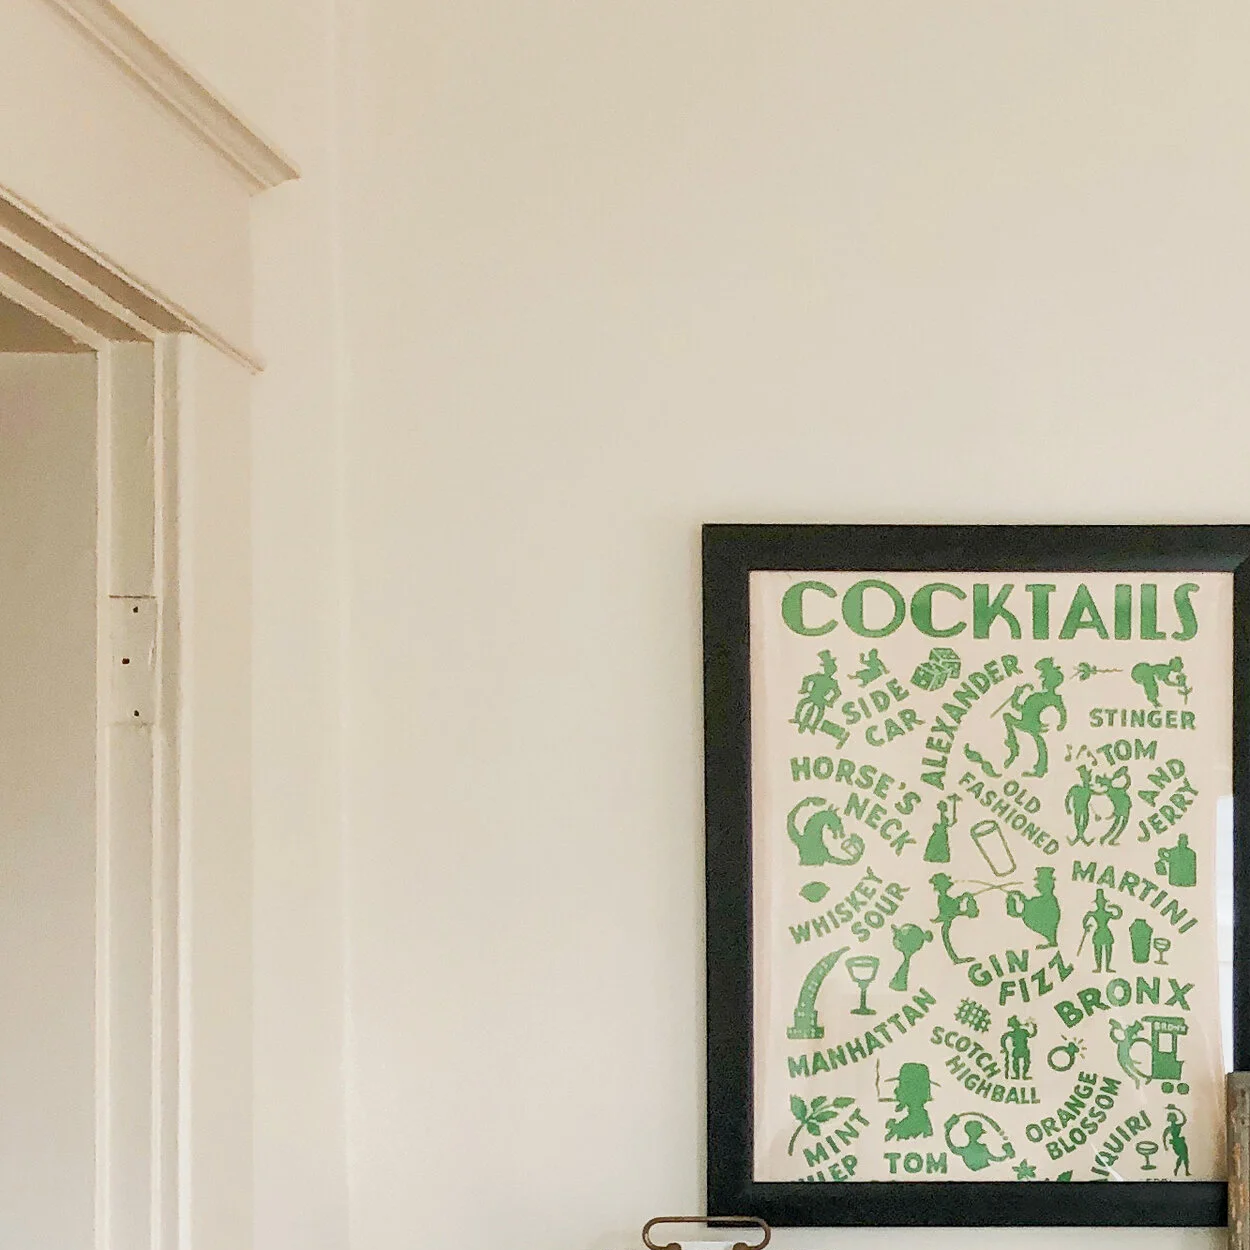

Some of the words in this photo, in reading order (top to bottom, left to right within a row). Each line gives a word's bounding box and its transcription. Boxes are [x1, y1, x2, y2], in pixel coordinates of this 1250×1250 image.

[781, 579, 1199, 641] COCKTAILS
[842, 679, 910, 724] SIDE
[866, 709, 925, 746] CAR
[921, 654, 1023, 790] ALEXANDER
[1089, 708, 1196, 730] STINGER
[791, 756, 922, 815] HORSE'S
[1003, 780, 1041, 813] OLD
[1097, 738, 1158, 766] TOM
[1138, 758, 1187, 807] AND
[844, 793, 917, 855] NECK
[958, 771, 1060, 855] FASHIONED
[1138, 778, 1199, 842] JERRY
[788, 866, 883, 944] WHISKEY
[852, 882, 910, 942] SOUR
[1072, 861, 1198, 934] MARTINI
[967, 949, 1029, 987] GIN
[1000, 950, 1075, 1006] FIZZ
[787, 987, 936, 1078] MANHATTAN
[1053, 976, 1195, 1029] BRONX
[930, 1026, 1000, 1079] SCOTCH
[945, 1054, 1041, 1105] HIGHBALL
[802, 1107, 870, 1167] MINT
[1025, 1071, 1098, 1143] ORANGE
[1045, 1077, 1122, 1161] BLOSSOM
[883, 1151, 948, 1175] TOM
[1090, 1110, 1151, 1182] IQUIRI
